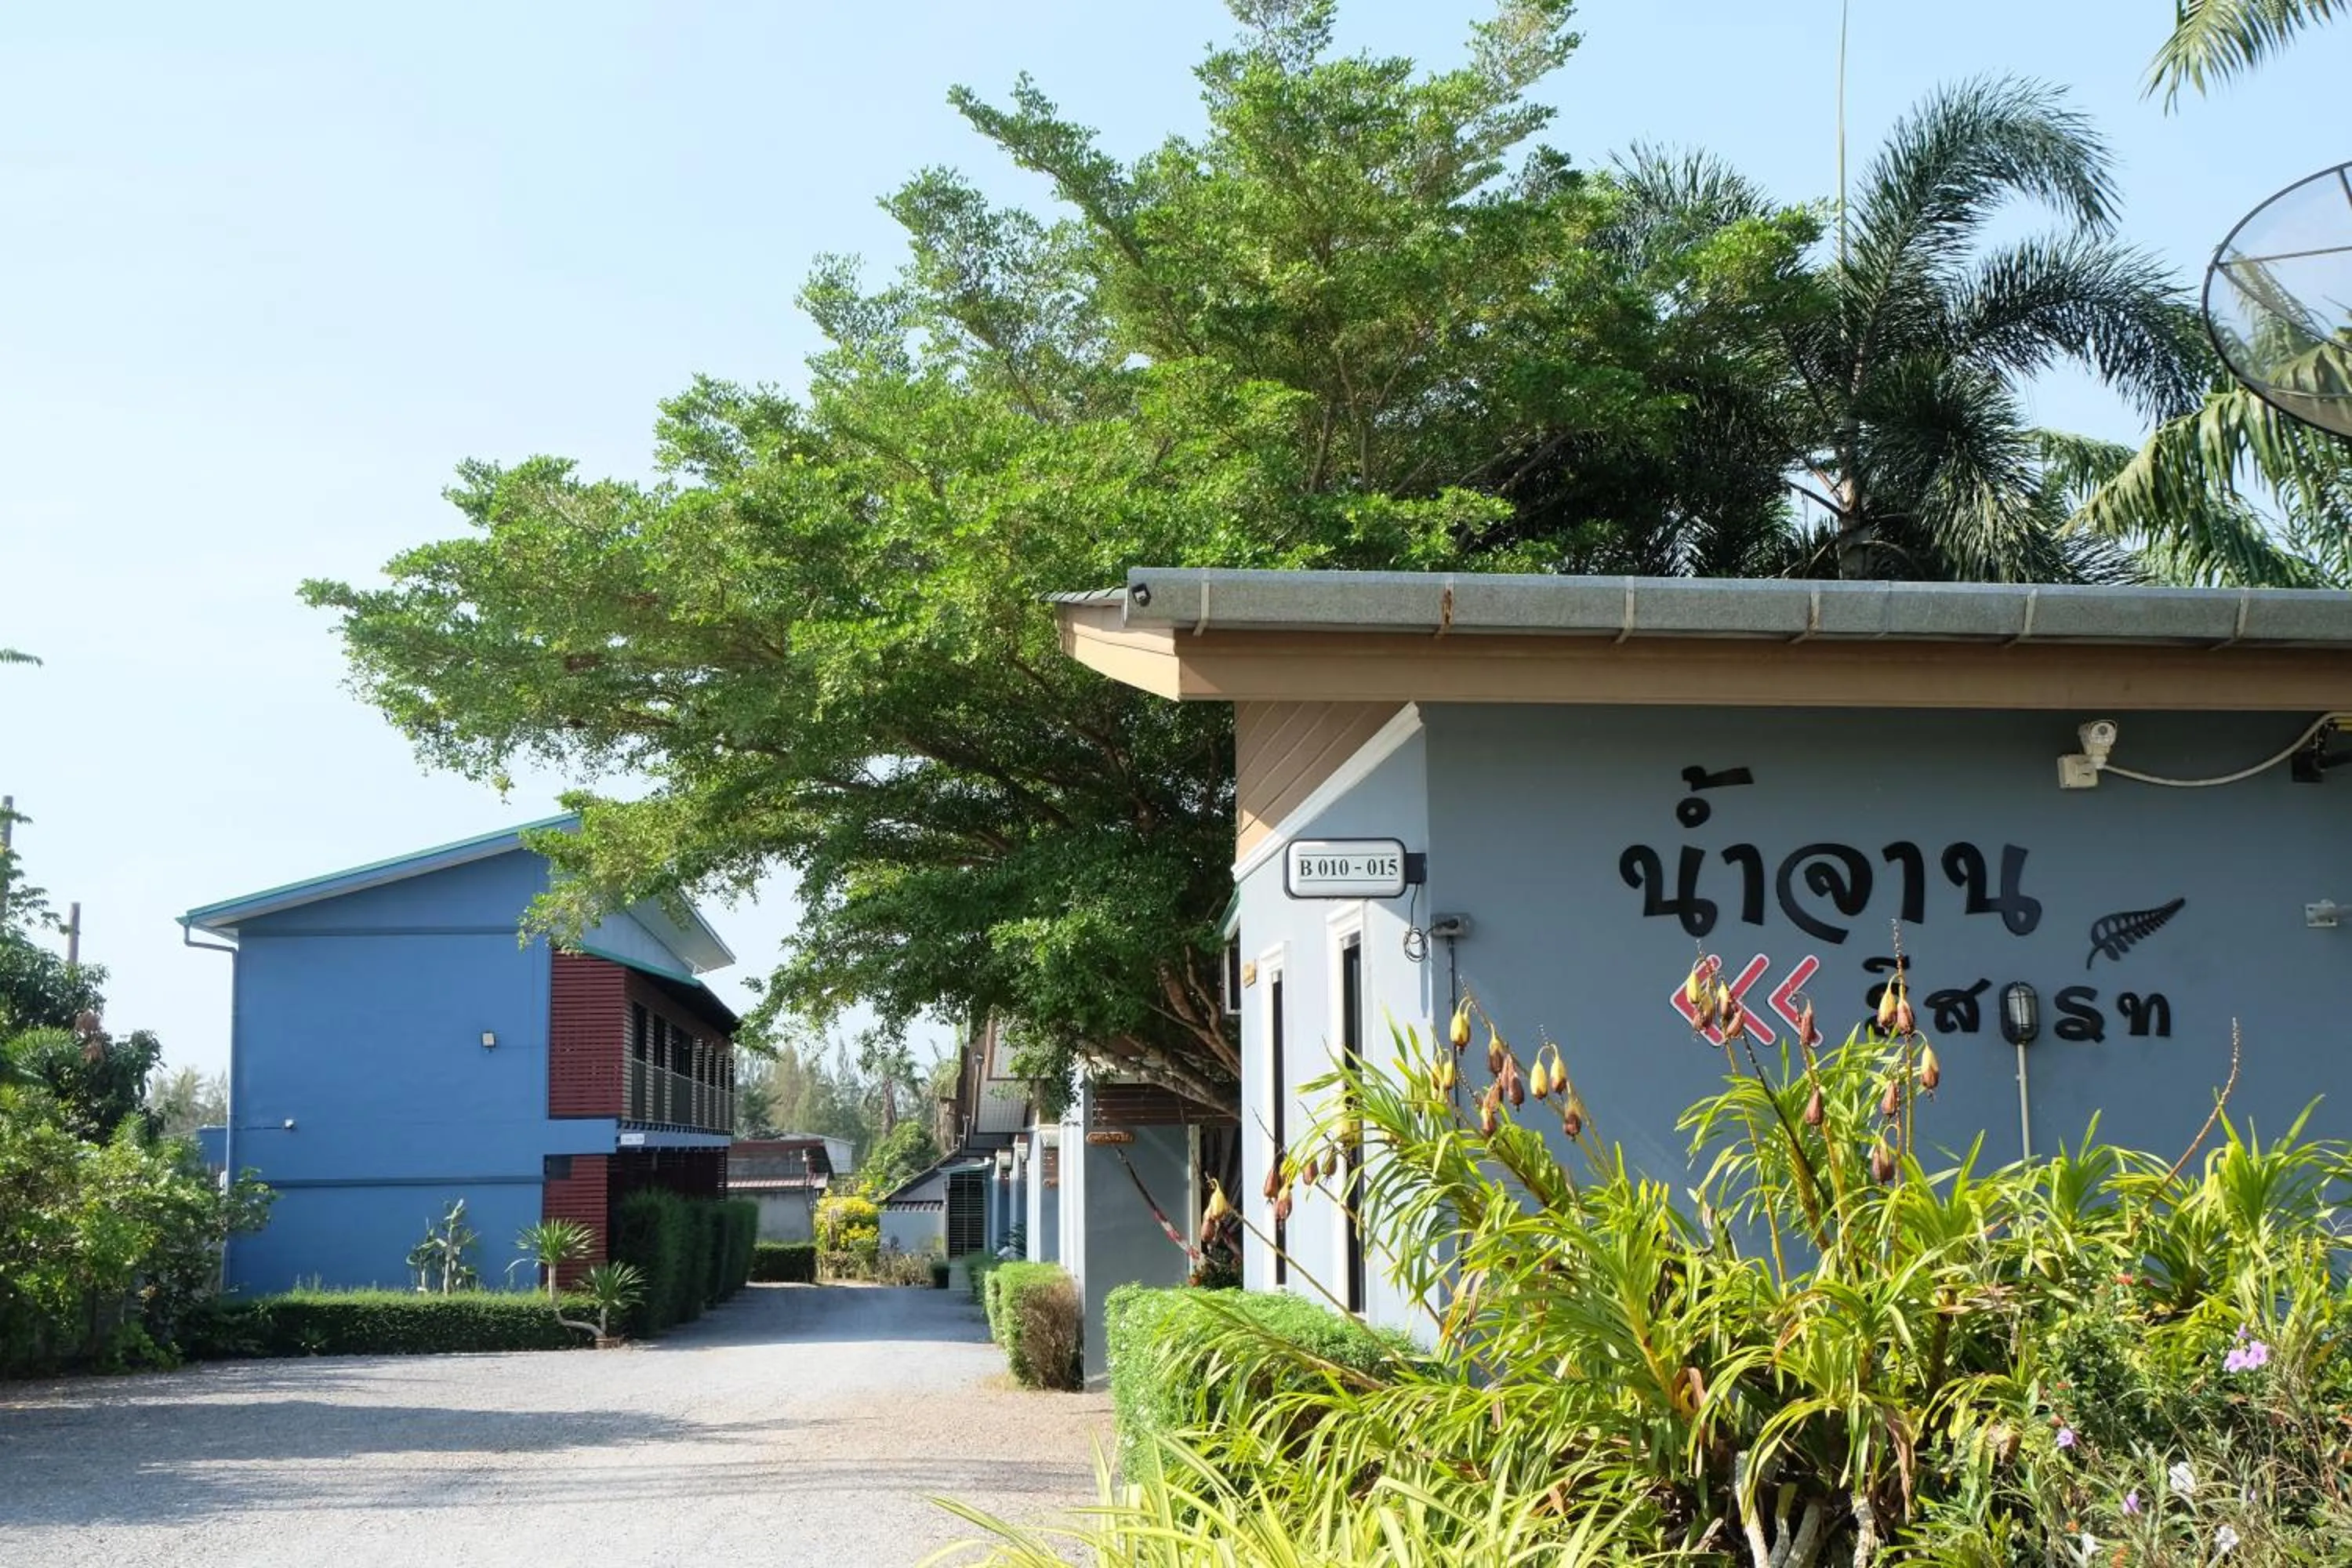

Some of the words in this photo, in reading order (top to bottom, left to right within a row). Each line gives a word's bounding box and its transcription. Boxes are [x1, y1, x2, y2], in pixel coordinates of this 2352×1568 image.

[1299, 859, 1312, 877] B
[1318, 858, 1349, 877] 010
[1367, 858, 1398, 877] 015
